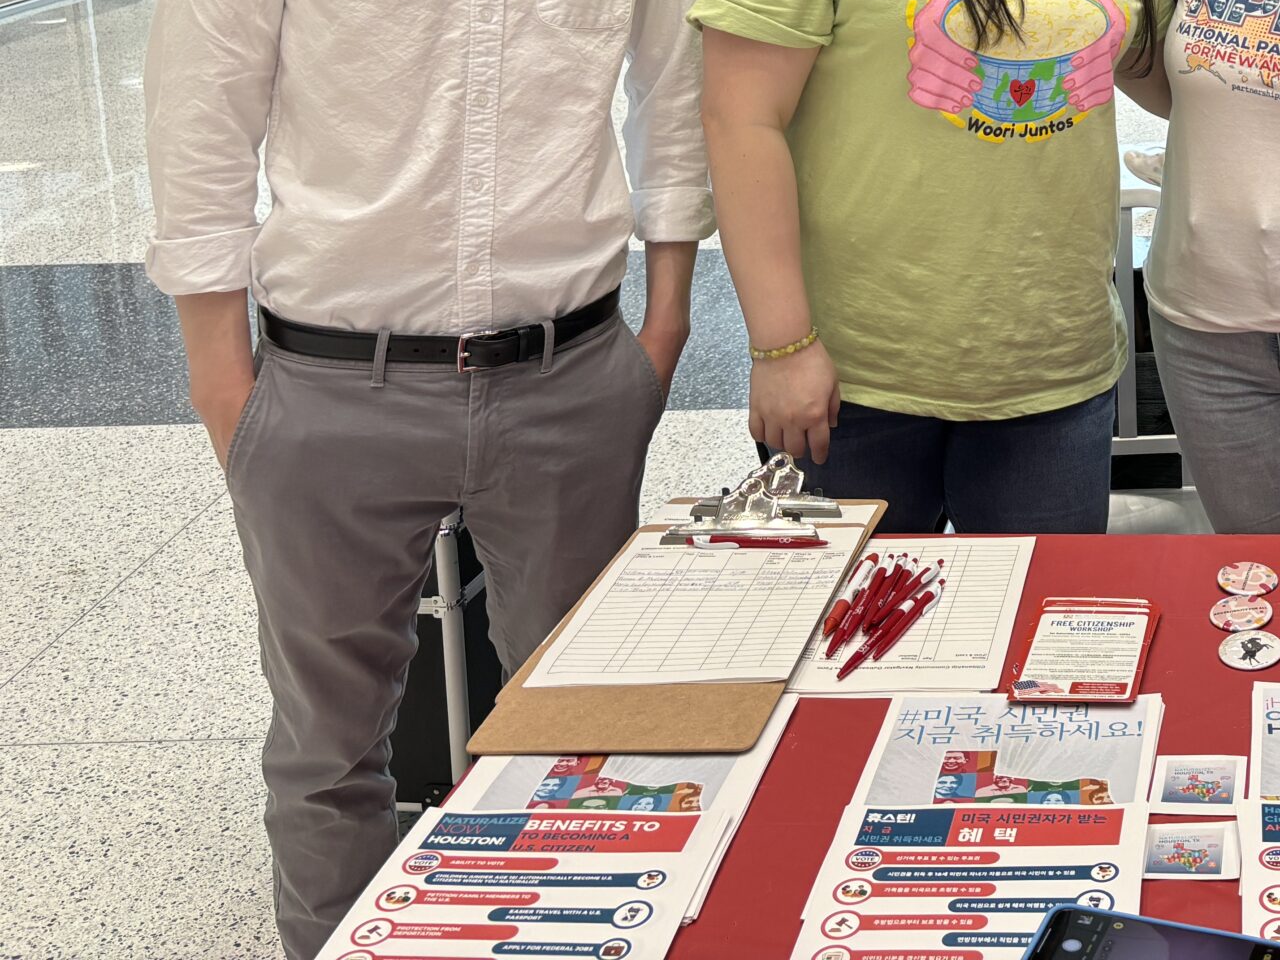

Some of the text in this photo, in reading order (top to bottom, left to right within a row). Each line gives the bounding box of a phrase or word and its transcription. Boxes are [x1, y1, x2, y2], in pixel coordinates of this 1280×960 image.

[1176, 22, 1250, 50] NATIONAL
[1184, 42, 1210, 58] FOR
[1215, 47, 1256, 68] NEW
[967, 116, 1074, 138] Woori Juntos
[897, 702, 1090, 725] #미국 시민권
[895, 721, 1143, 745] 지금 취득하세요!
[442, 815, 528, 826] NATURALIZE
[865, 813, 916, 824] 휴스턴!
[961, 813, 1107, 824] 미국 시민권자가 받는
[434, 824, 489, 834] NOW
[524, 819, 661, 832] BENEFITS TO
[427, 834, 507, 846] HOUSTON!
[520, 832, 631, 841] TO BECOMING A
[511, 844, 596, 852] U.S. CITIZEN
